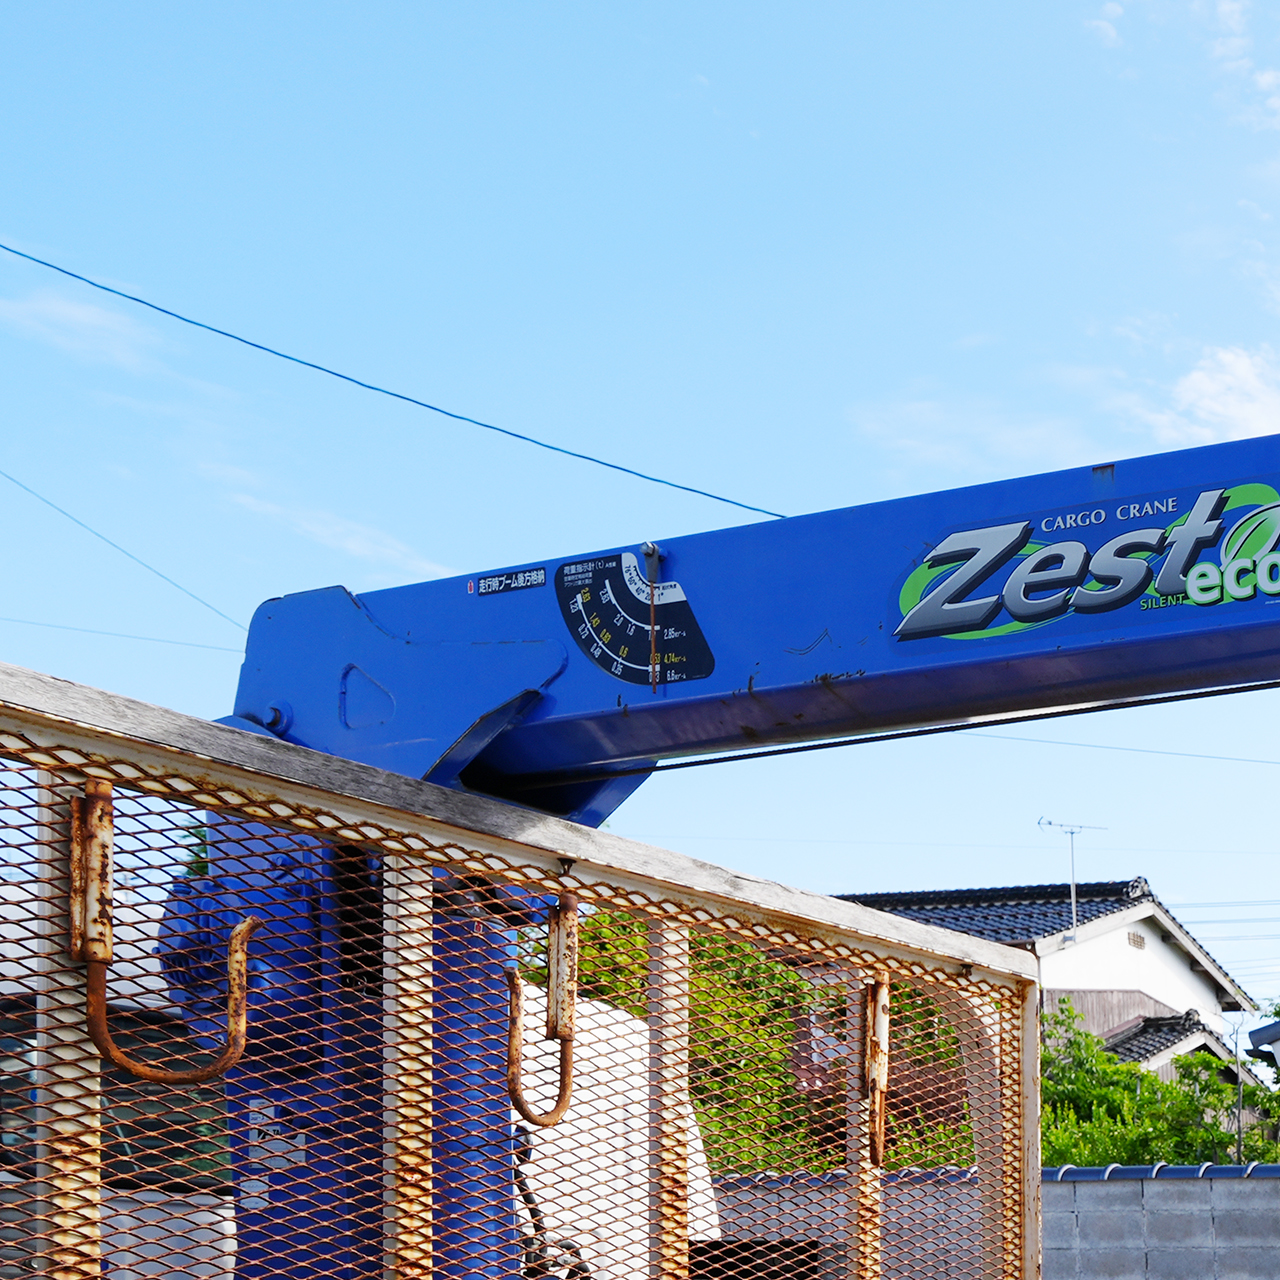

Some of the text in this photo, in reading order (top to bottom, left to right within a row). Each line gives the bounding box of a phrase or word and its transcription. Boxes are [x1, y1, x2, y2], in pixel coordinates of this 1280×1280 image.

[1041, 497, 1178, 532] CARGO CRANE
[893, 489, 1226, 641] Zest
[1140, 593, 1185, 610] SILENT
